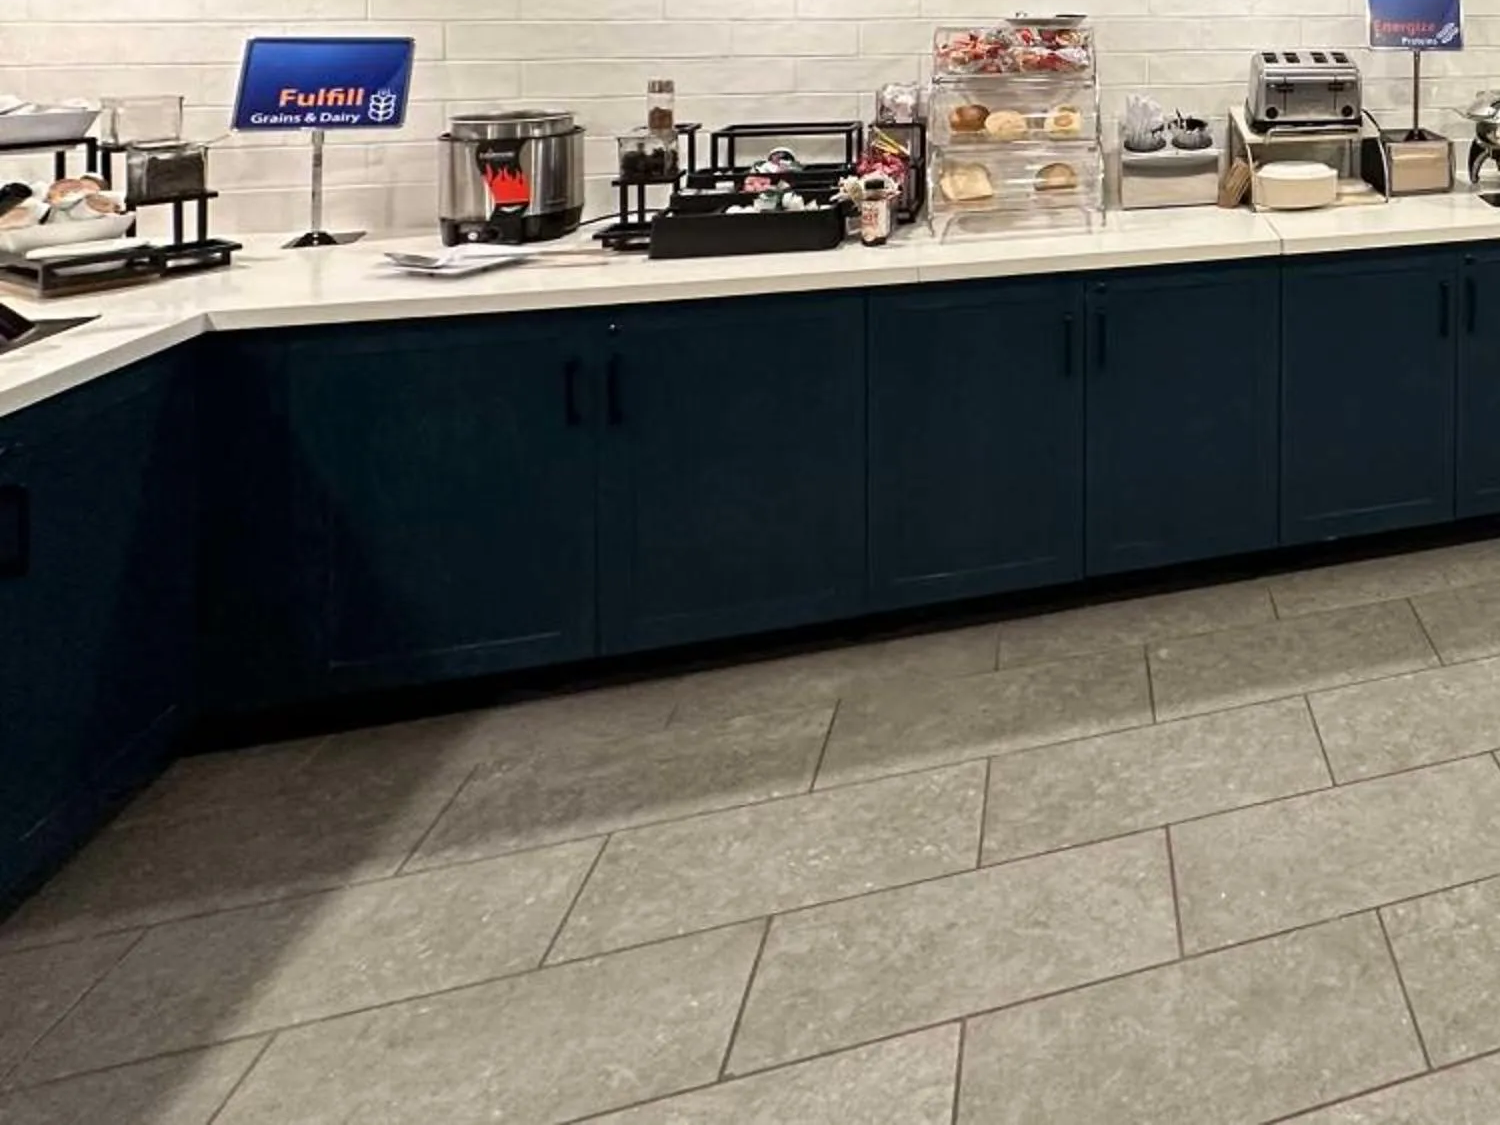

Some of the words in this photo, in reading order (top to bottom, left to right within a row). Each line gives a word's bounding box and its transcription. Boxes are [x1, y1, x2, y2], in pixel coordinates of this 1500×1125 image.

[278, 87, 366, 107] Fulfill
[251, 112, 301, 124] Grains
[304, 112, 316, 123] &
[319, 111, 361, 124] Dairy
